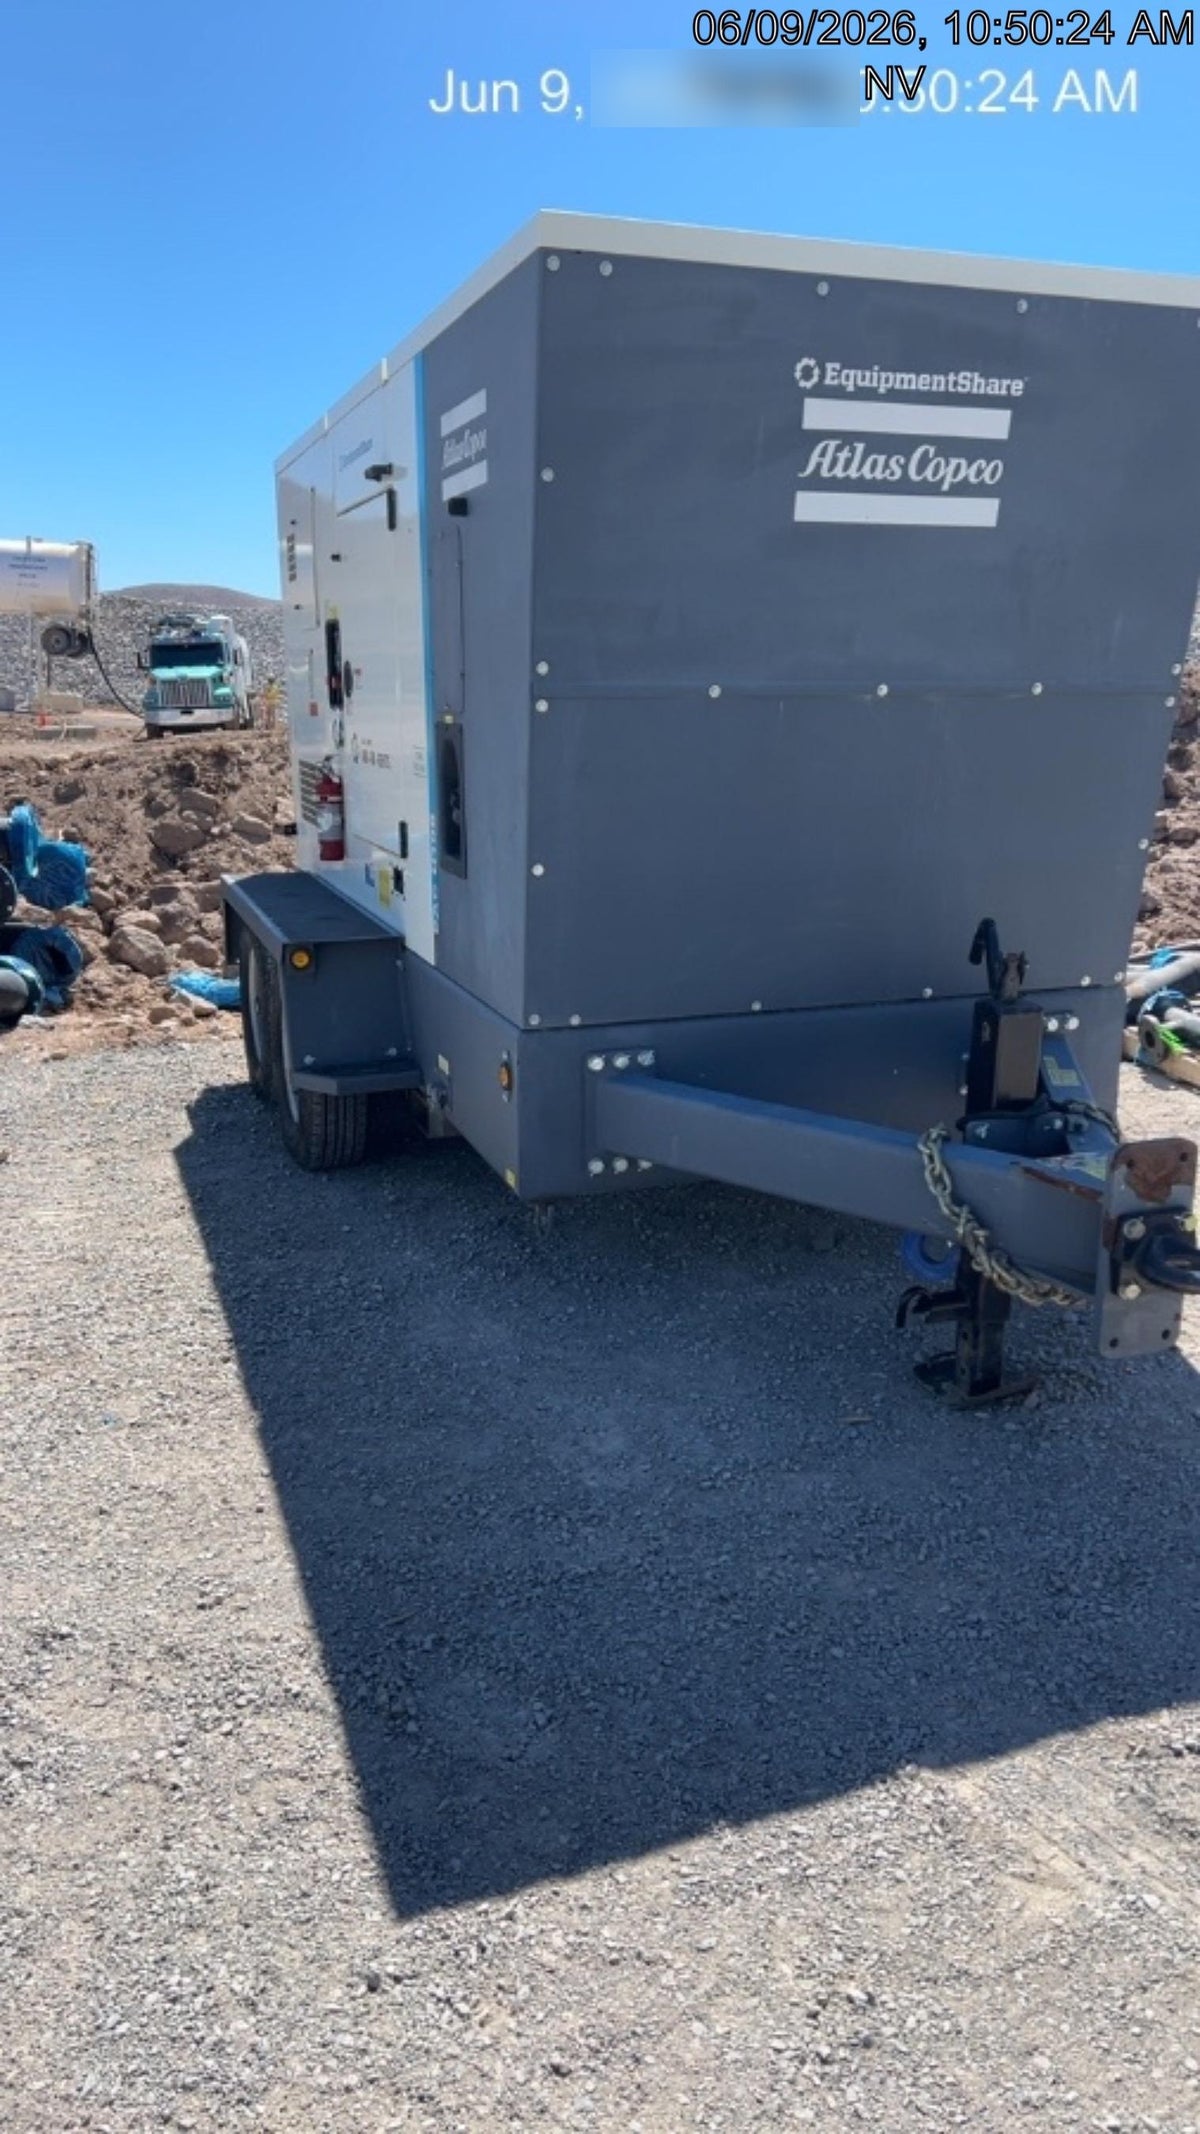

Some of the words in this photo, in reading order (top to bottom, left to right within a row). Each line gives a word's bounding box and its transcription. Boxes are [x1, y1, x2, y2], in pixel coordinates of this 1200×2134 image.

[822, 361, 1025, 397] EquipmentShare
[797, 439, 905, 483] Atlas
[907, 444, 1004, 492] Copco
